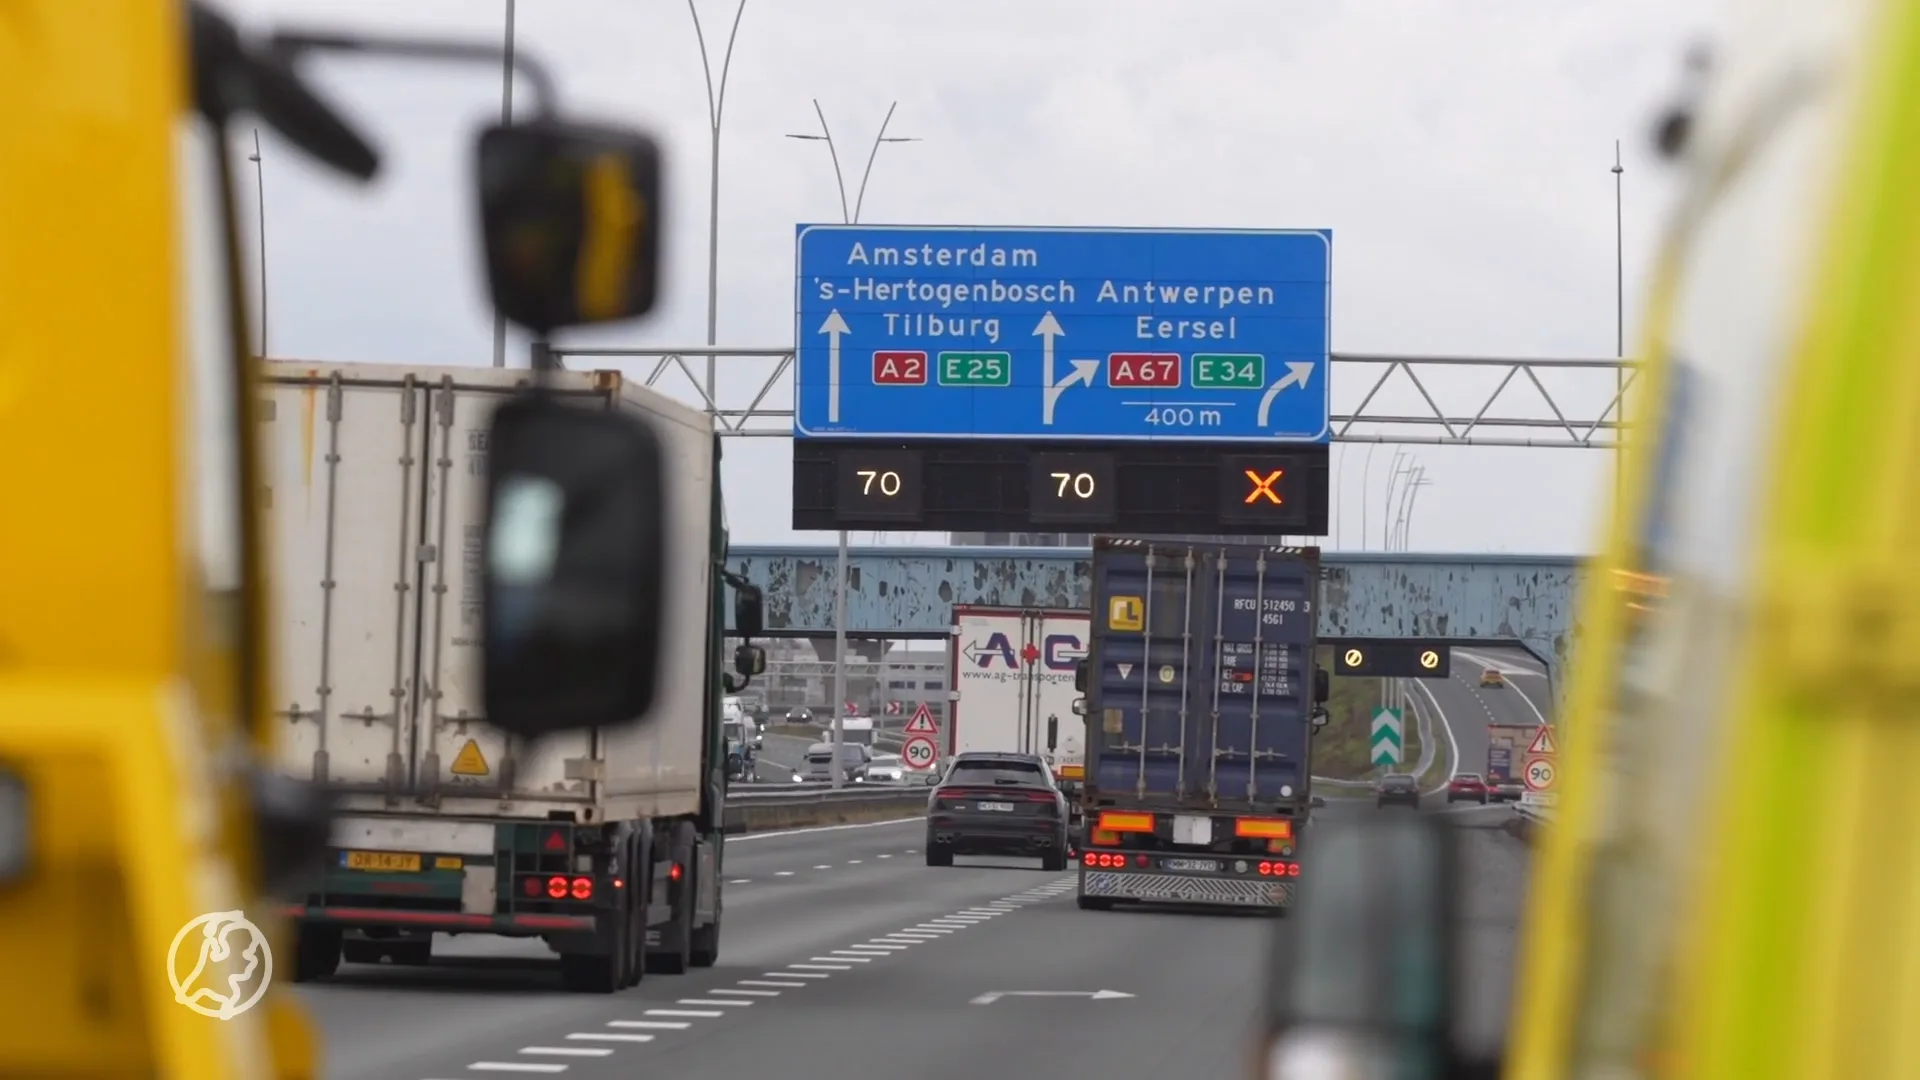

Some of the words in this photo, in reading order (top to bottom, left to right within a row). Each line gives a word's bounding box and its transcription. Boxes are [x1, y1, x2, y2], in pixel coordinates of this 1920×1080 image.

[847, 242, 1038, 267] Amsterdam
[814, 277, 1076, 308] 's-Hertogenbosch
[1096, 280, 1275, 309] Antwerpen
[883, 313, 1000, 344] Tilburg
[1136, 316, 1237, 340] Eersel
[880, 358, 921, 379] A2
[946, 358, 1002, 379] E25
[1115, 360, 1175, 381] A67
[1199, 360, 1256, 381] E34
[1144, 407, 1195, 427] 400
[1199, 409, 1222, 427] m
[856, 470, 902, 497] 70
[1050, 471, 1096, 499] 70
[1234, 599, 1257, 610] RFCU
[1263, 599, 1296, 612] 512450
[1303, 601, 1311, 613] 3
[909, 746, 931, 760] 90
[1530, 767, 1552, 781] 90
